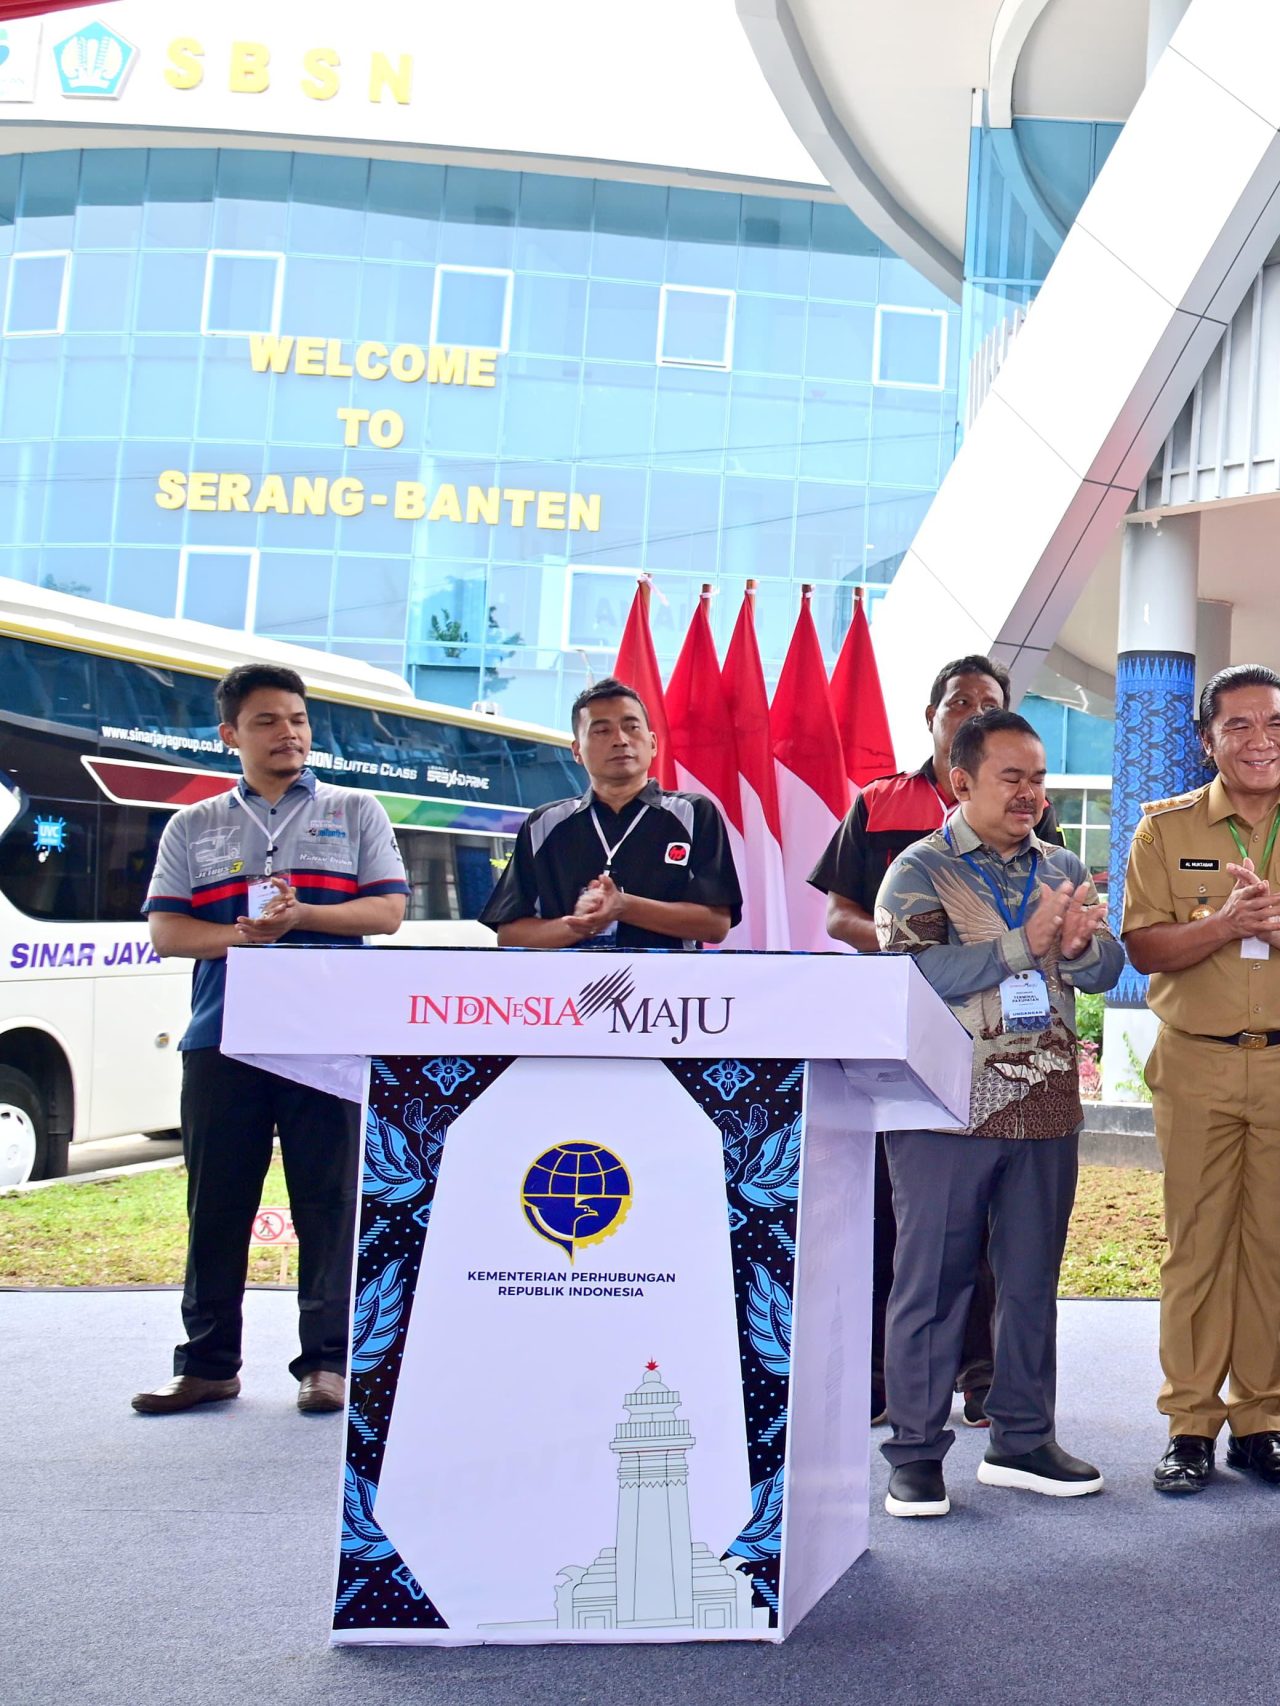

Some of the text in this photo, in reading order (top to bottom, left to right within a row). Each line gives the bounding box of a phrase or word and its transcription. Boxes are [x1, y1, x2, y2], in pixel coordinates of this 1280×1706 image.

[249, 335, 498, 388] WELCOME
[336, 407, 404, 449] TO
[155, 471, 602, 532] SERANG-BANTEN
[101, 726, 223, 753] www.sinarjayagroup.co.id
[10, 942, 161, 968] SINAR JAYA
[407, 995, 736, 1044] INDONESIA MAJU
[467, 1271, 676, 1282] KEMENTERIAN PERHUBUNGAN
[498, 1286, 644, 1297] REPUBLIK INDONESIA
